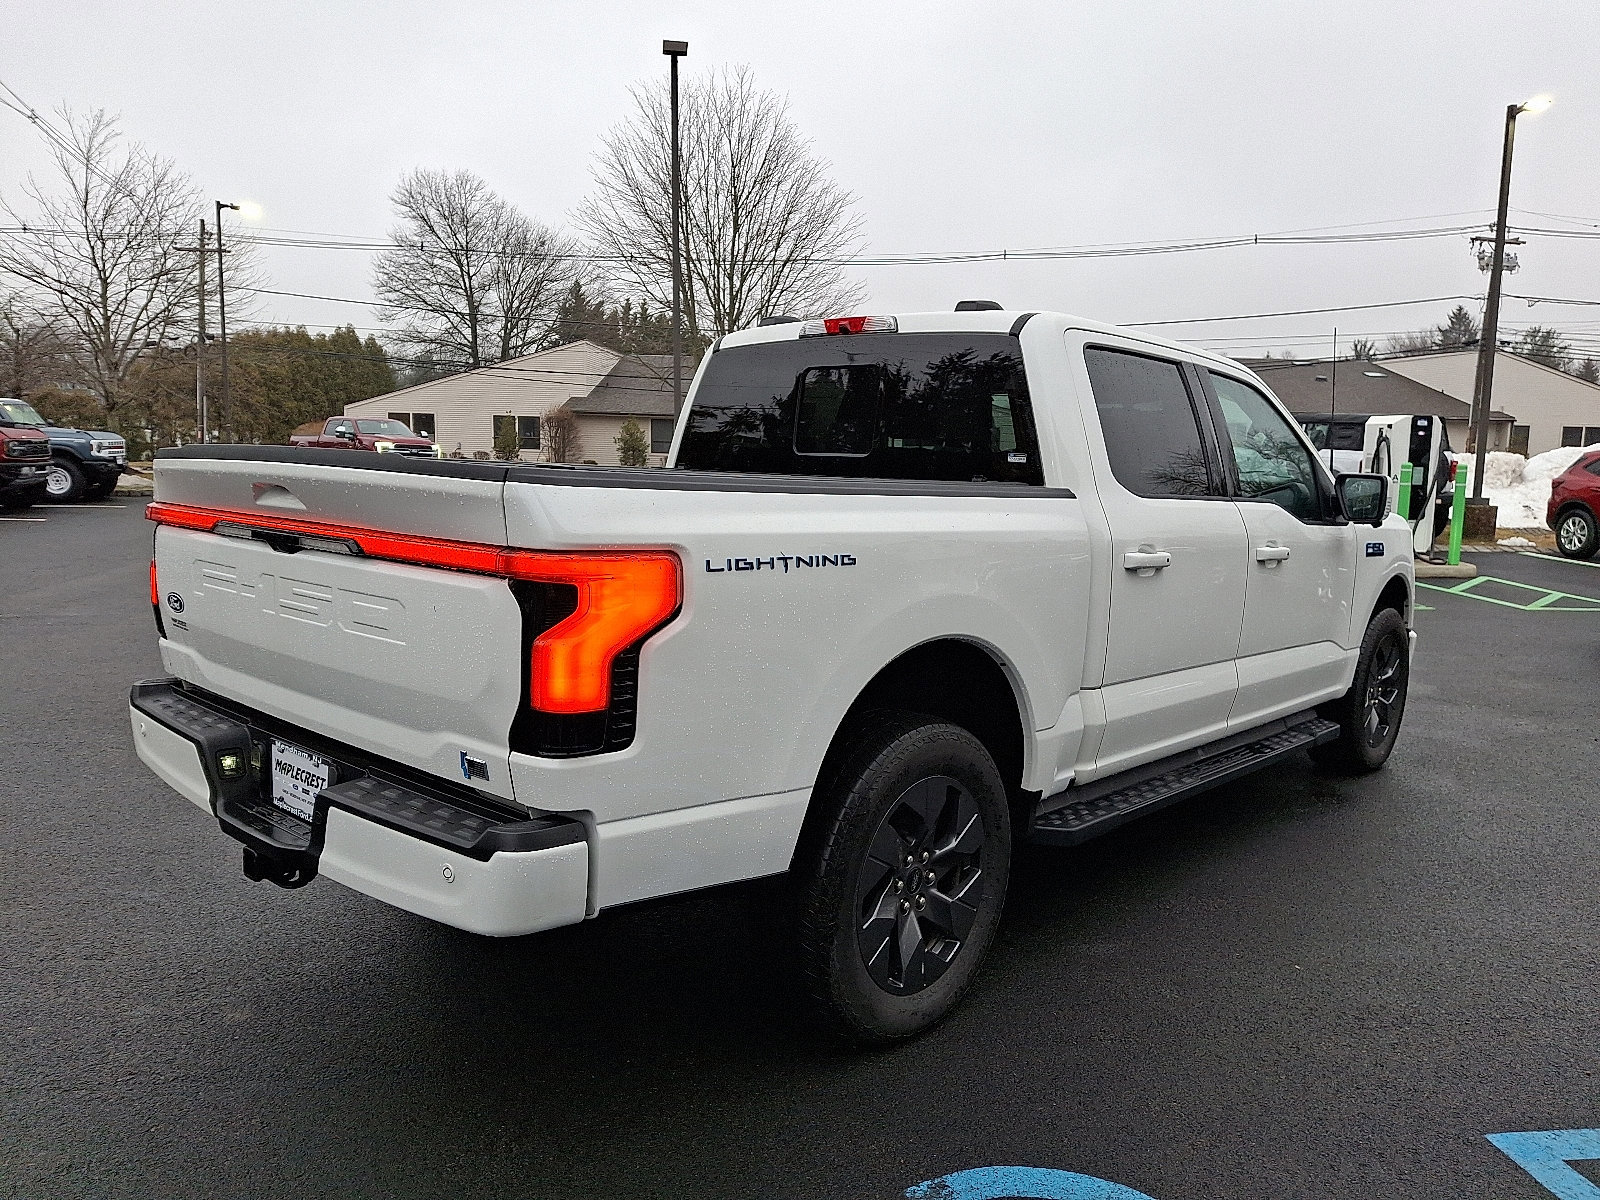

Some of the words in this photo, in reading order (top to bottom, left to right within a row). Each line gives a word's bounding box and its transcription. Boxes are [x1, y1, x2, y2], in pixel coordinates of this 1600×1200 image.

[705, 552, 857, 573] LIGHTNING
[192, 558, 407, 646] F-150
[274, 757, 326, 790] MAPLECREST
